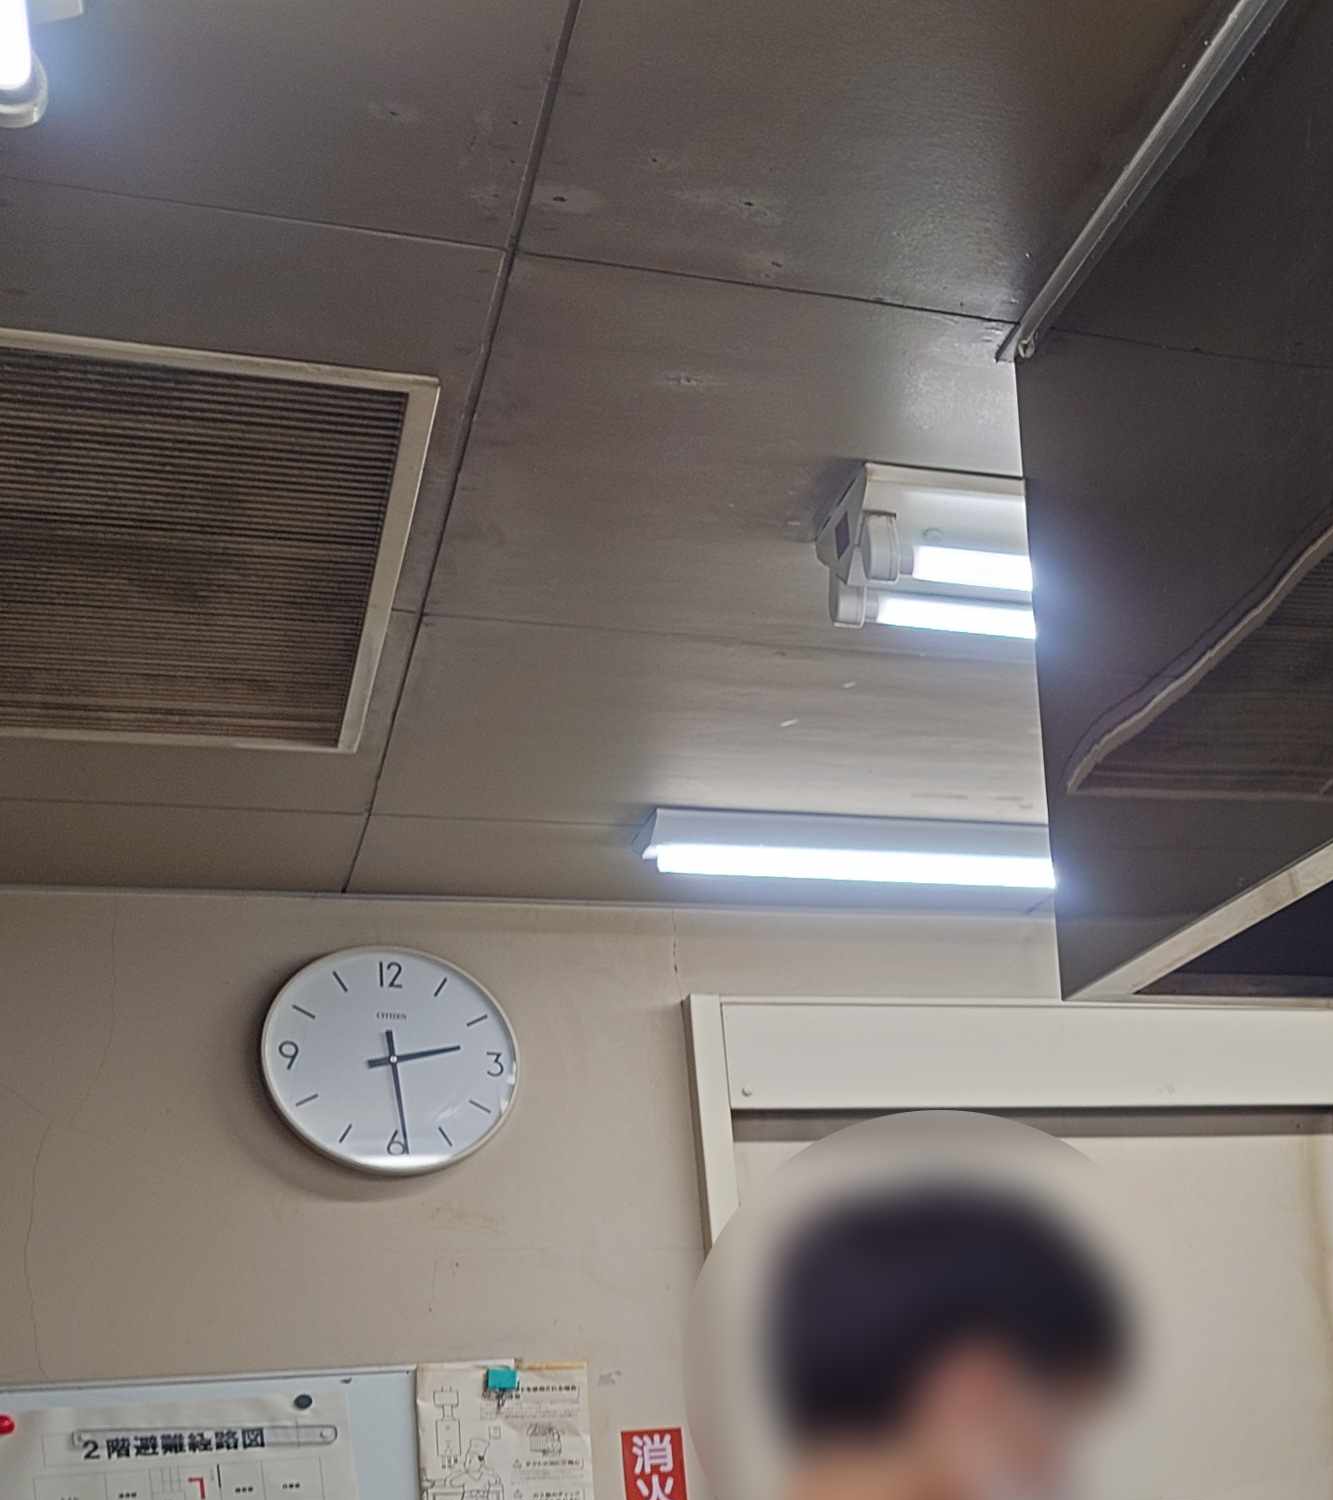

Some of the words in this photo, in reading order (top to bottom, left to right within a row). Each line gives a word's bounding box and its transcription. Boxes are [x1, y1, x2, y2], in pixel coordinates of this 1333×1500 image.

[378, 961, 403, 988] 12
[278, 1040, 299, 1070] 9
[486, 1051, 505, 1077] 3
[386, 1129, 408, 1156] 6
[83, 1427, 266, 1460] 2階避難経路図
